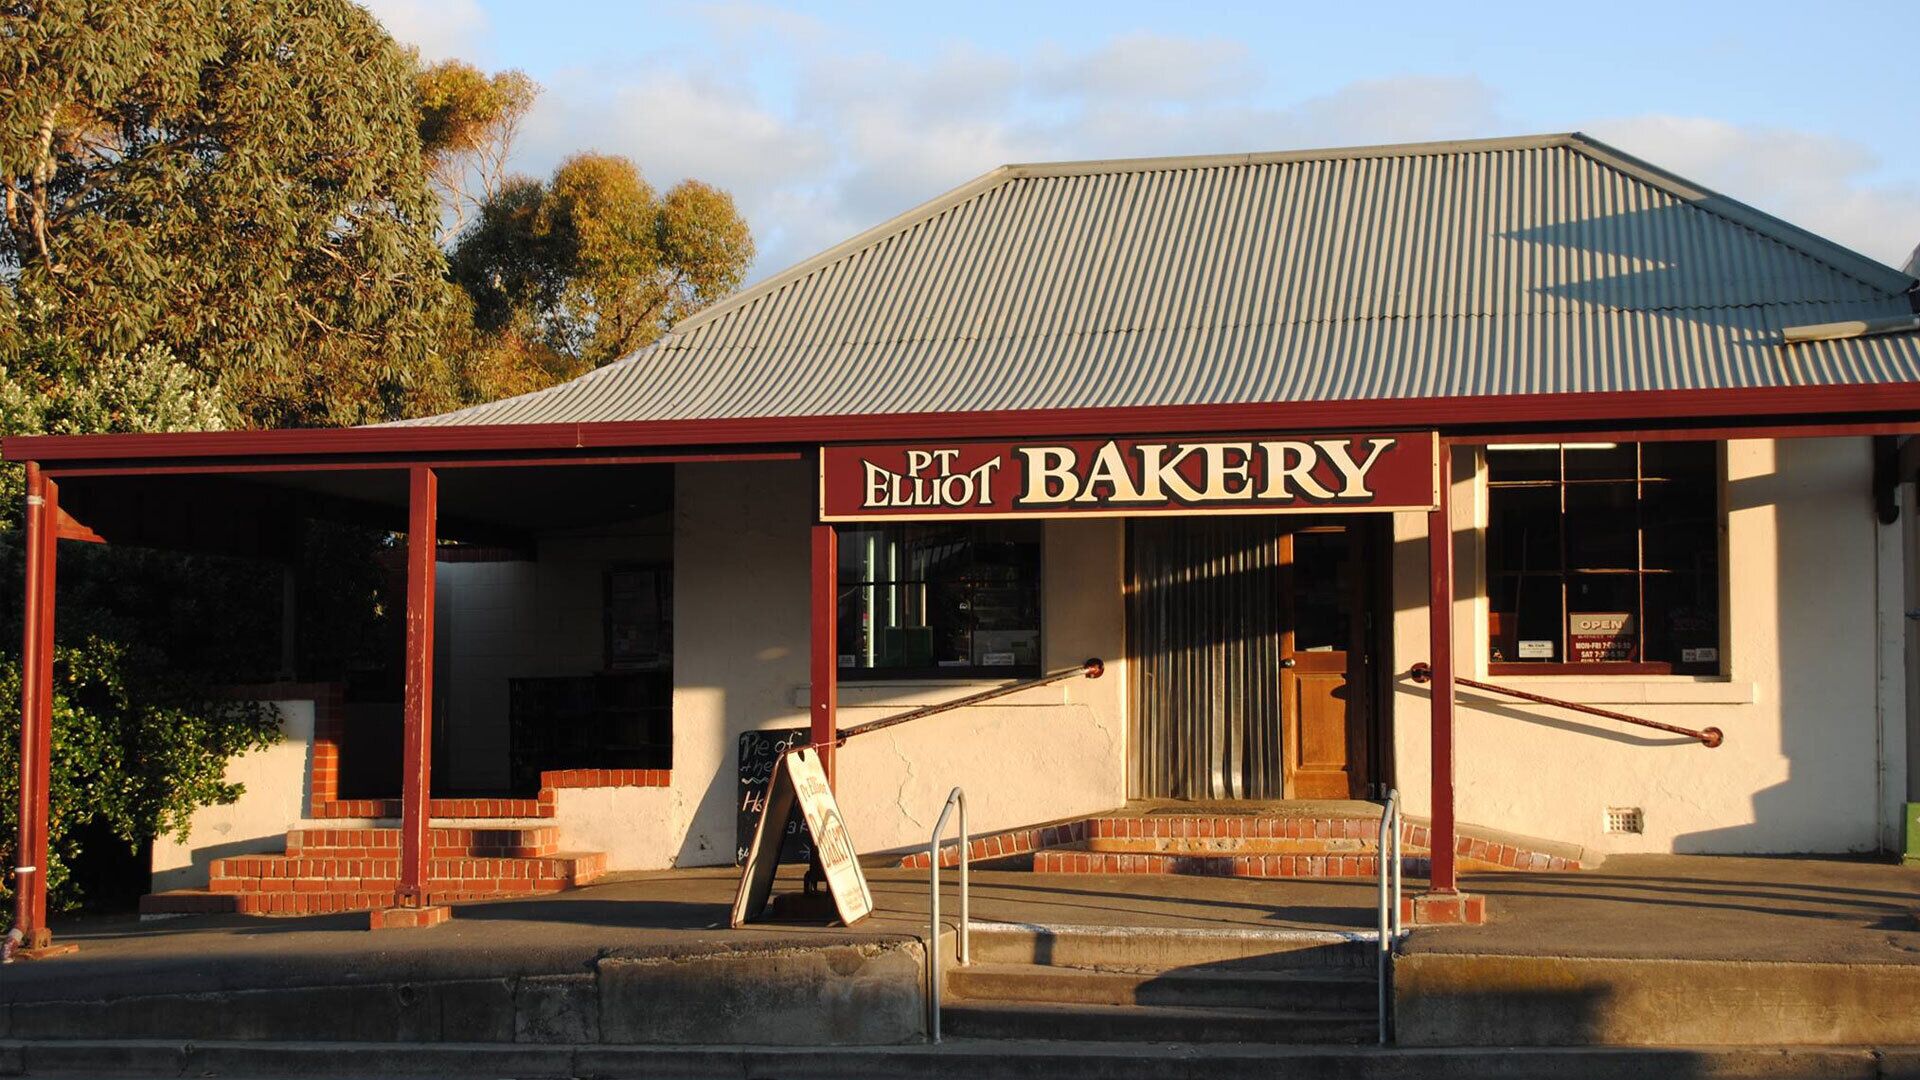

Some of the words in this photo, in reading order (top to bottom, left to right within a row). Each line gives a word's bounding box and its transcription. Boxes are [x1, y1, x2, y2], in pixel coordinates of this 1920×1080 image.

[906, 448, 959, 478] PT
[1016, 438, 1396, 506] BAKERY
[862, 455, 1001, 508] ELLIOT
[1579, 620, 1623, 630] OPEN
[740, 731, 770, 760] Pie
